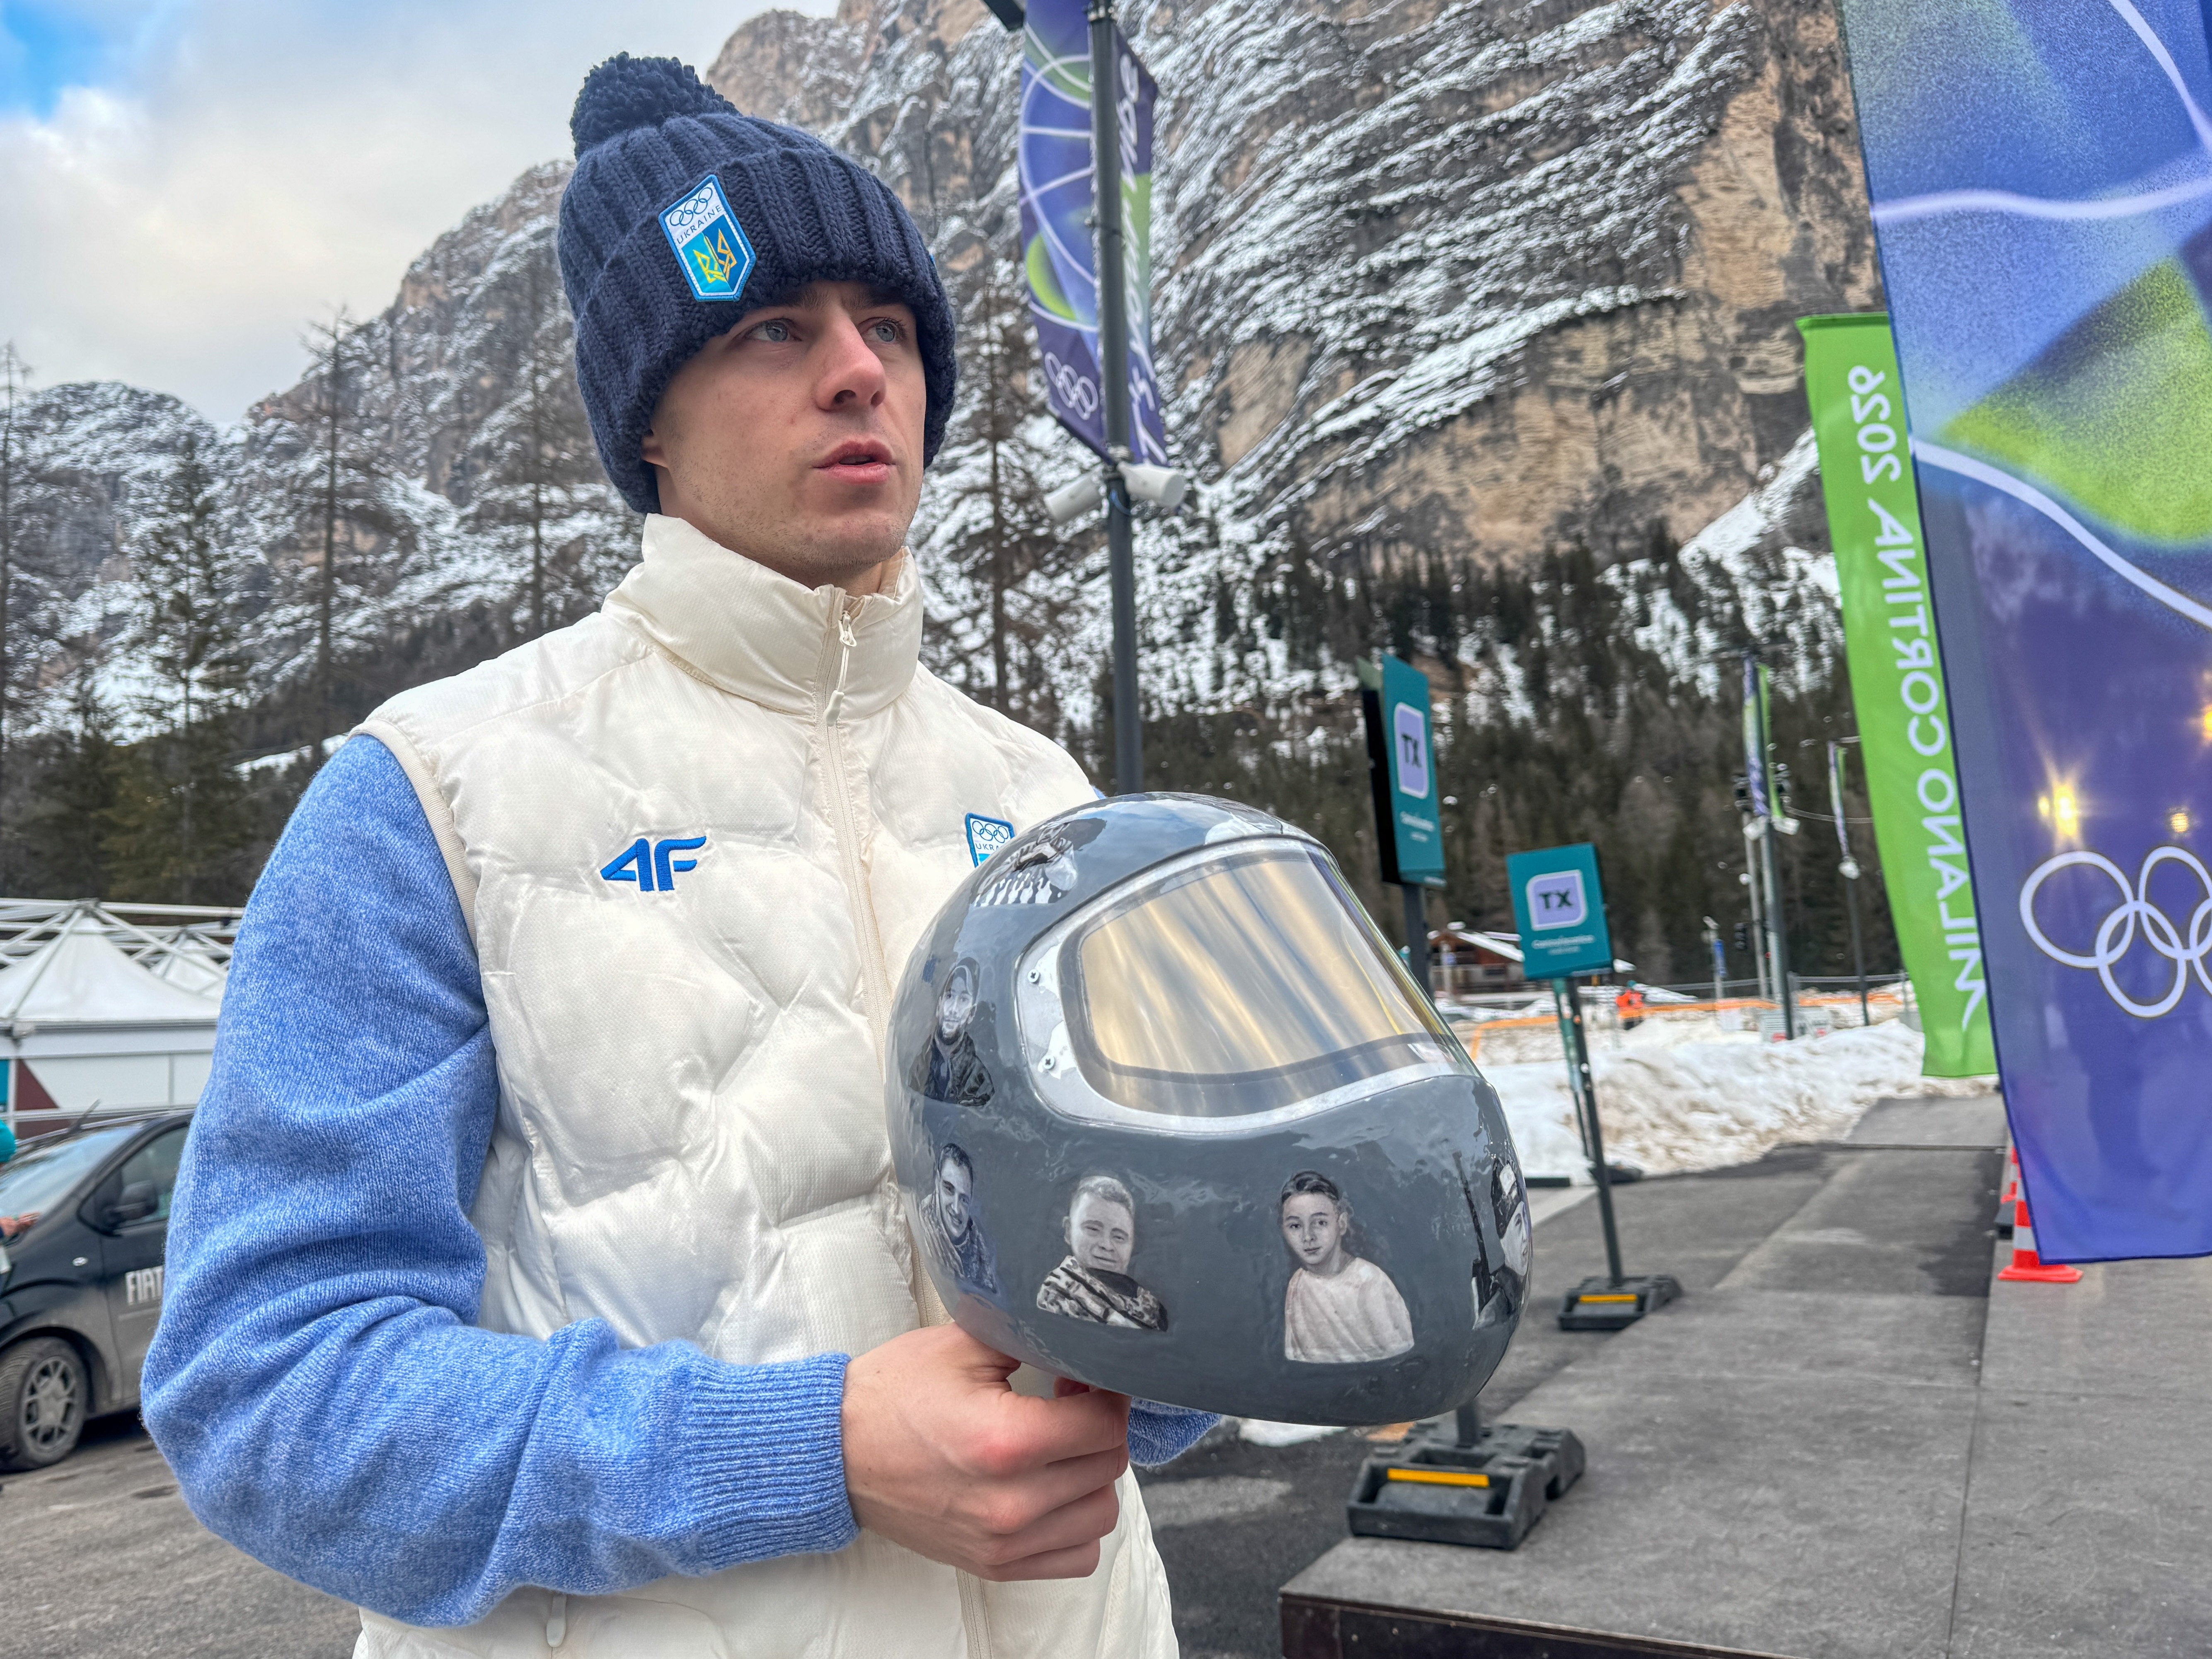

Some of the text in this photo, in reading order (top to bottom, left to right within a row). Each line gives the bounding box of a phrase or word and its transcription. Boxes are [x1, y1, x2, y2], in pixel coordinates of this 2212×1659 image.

[677, 205, 722, 244] UKRAINE
[1401, 733, 1423, 768] TX
[600, 836, 707, 892] 4F
[1538, 889, 1574, 910] TX
[125, 1265, 164, 1305] FIAT
